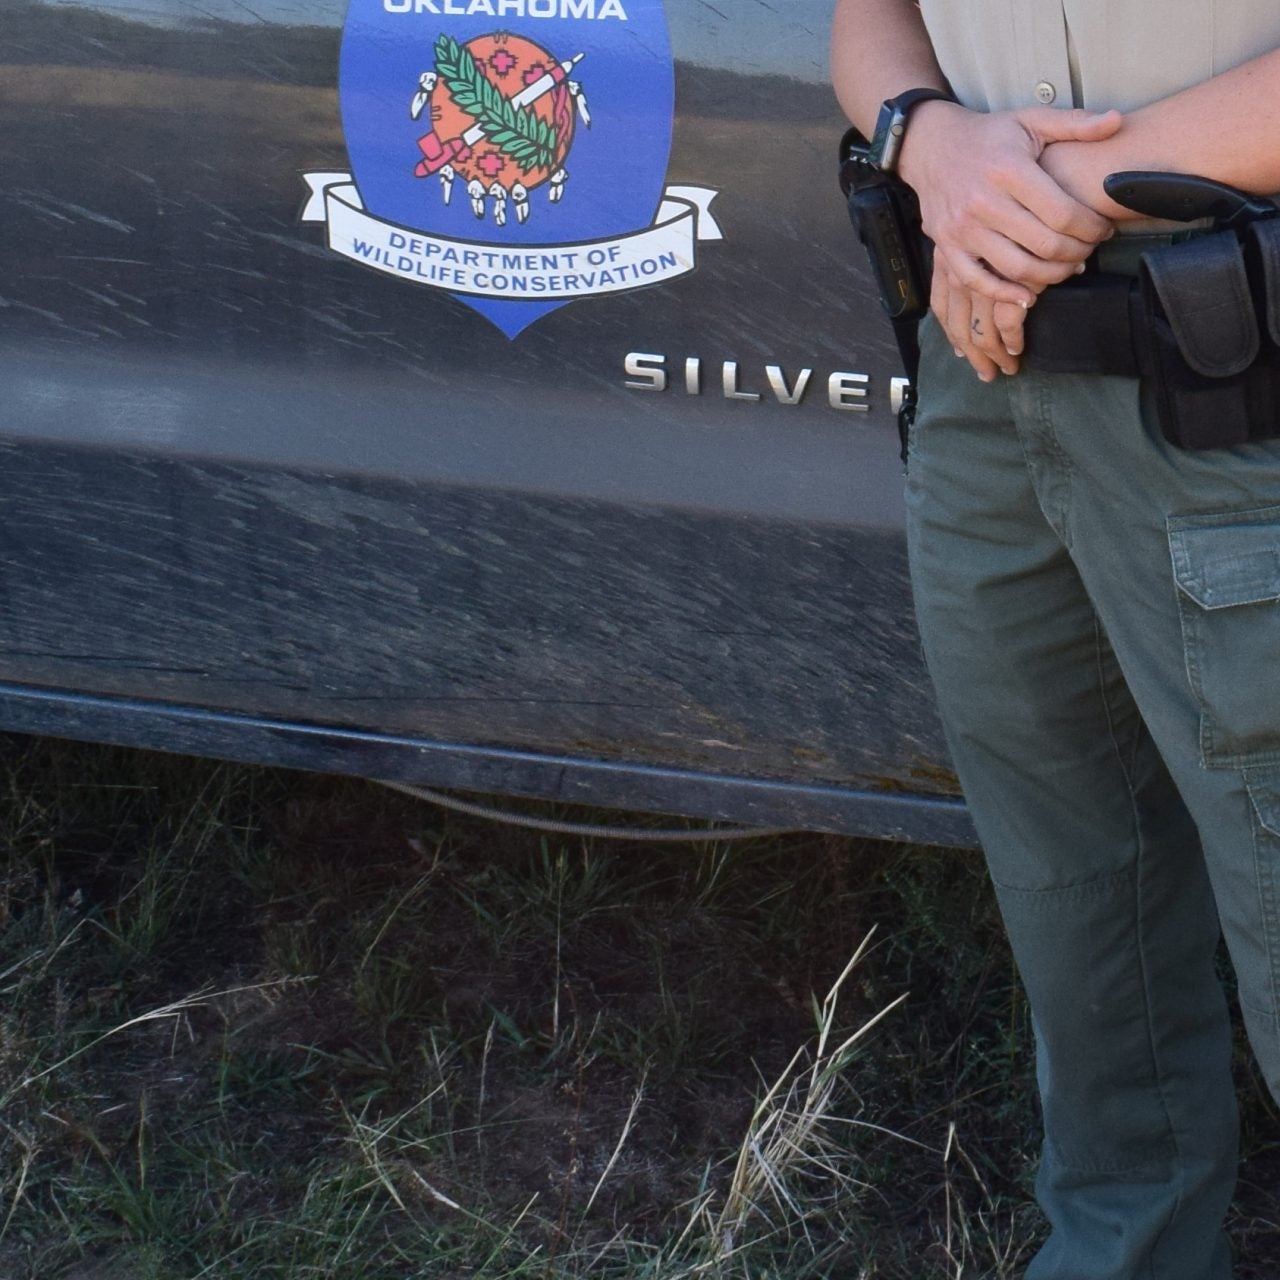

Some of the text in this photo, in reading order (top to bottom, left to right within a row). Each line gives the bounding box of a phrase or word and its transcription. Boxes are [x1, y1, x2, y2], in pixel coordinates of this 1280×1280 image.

[351, 237, 678, 292] WILDLIFE CONSERVATION
[388, 231, 622, 271] DEPARTMENT OF
